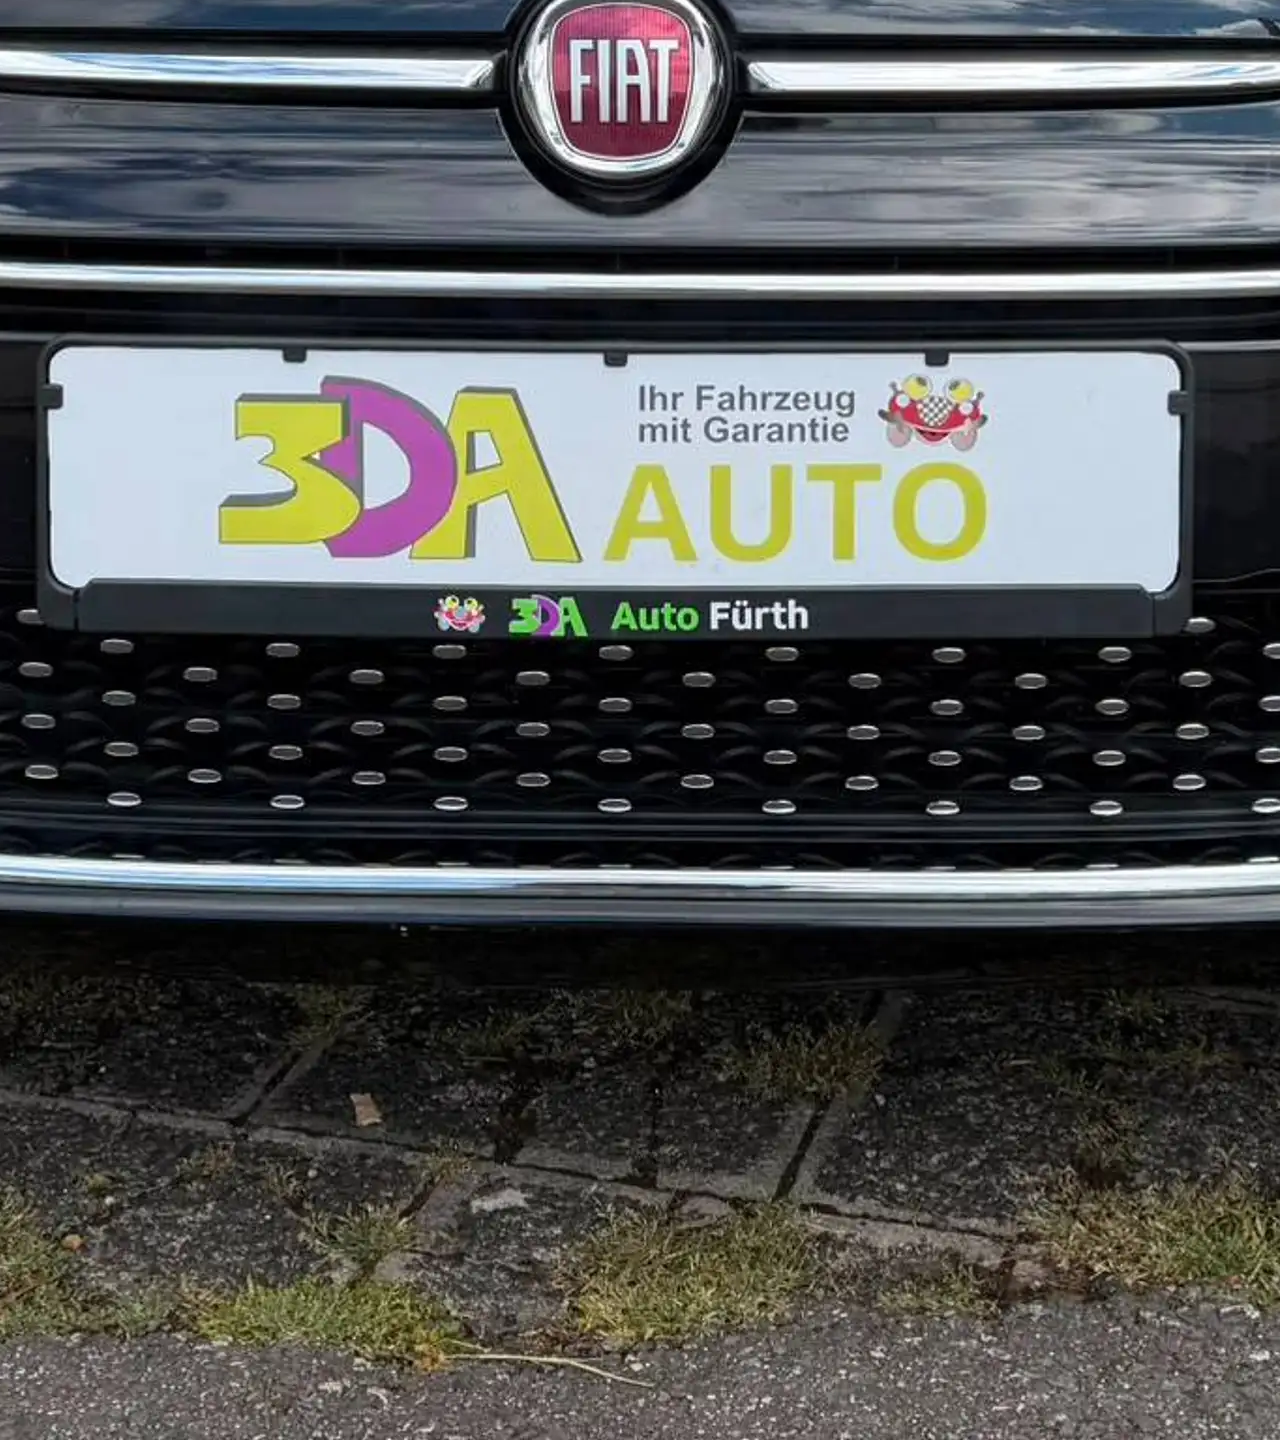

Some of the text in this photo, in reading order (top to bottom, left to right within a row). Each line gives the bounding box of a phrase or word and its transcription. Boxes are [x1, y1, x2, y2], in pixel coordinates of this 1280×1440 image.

[570, 39, 680, 124] FIAT
[637, 385, 856, 418] Ihr Fahrzeug
[638, 416, 850, 444] mit Garantie
[219, 375, 988, 563] 3DA AUTO
[508, 594, 809, 637] 3DA Auto Fürth
